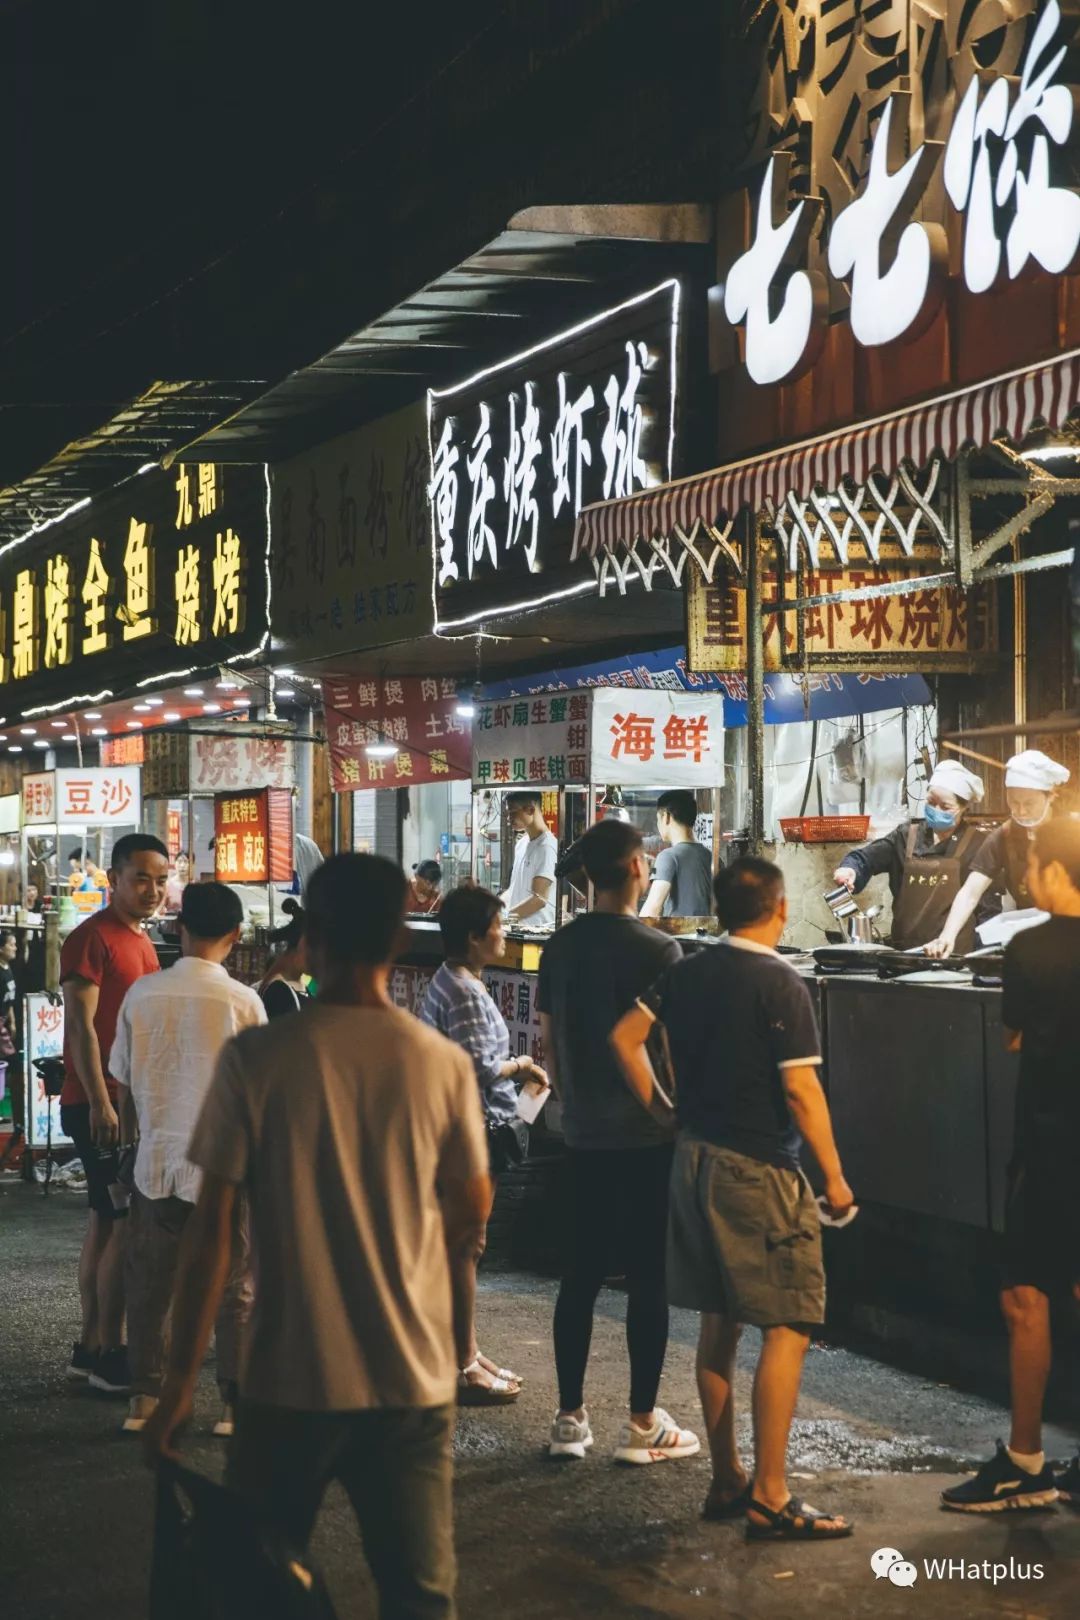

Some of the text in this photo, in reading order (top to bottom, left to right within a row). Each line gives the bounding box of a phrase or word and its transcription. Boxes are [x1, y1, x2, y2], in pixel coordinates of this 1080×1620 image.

[427, 340, 650, 587] 重庆烤虾球
[175, 463, 216, 530] 九鼎
[0, 517, 151, 684] 鼎烤全鱼
[175, 528, 241, 647] 烧烤
[332, 680, 405, 708] 三鲜煲
[337, 716, 408, 746] 皮蛋瘦肉粥
[609, 712, 711, 763] 海鲜
[196, 728, 287, 786] 烧烤
[341, 752, 413, 784] 猪肝煲
[64, 778, 133, 816] 豆沙
[221, 798, 258, 824] 重庆特色
[243, 831, 265, 873] 凉皮
